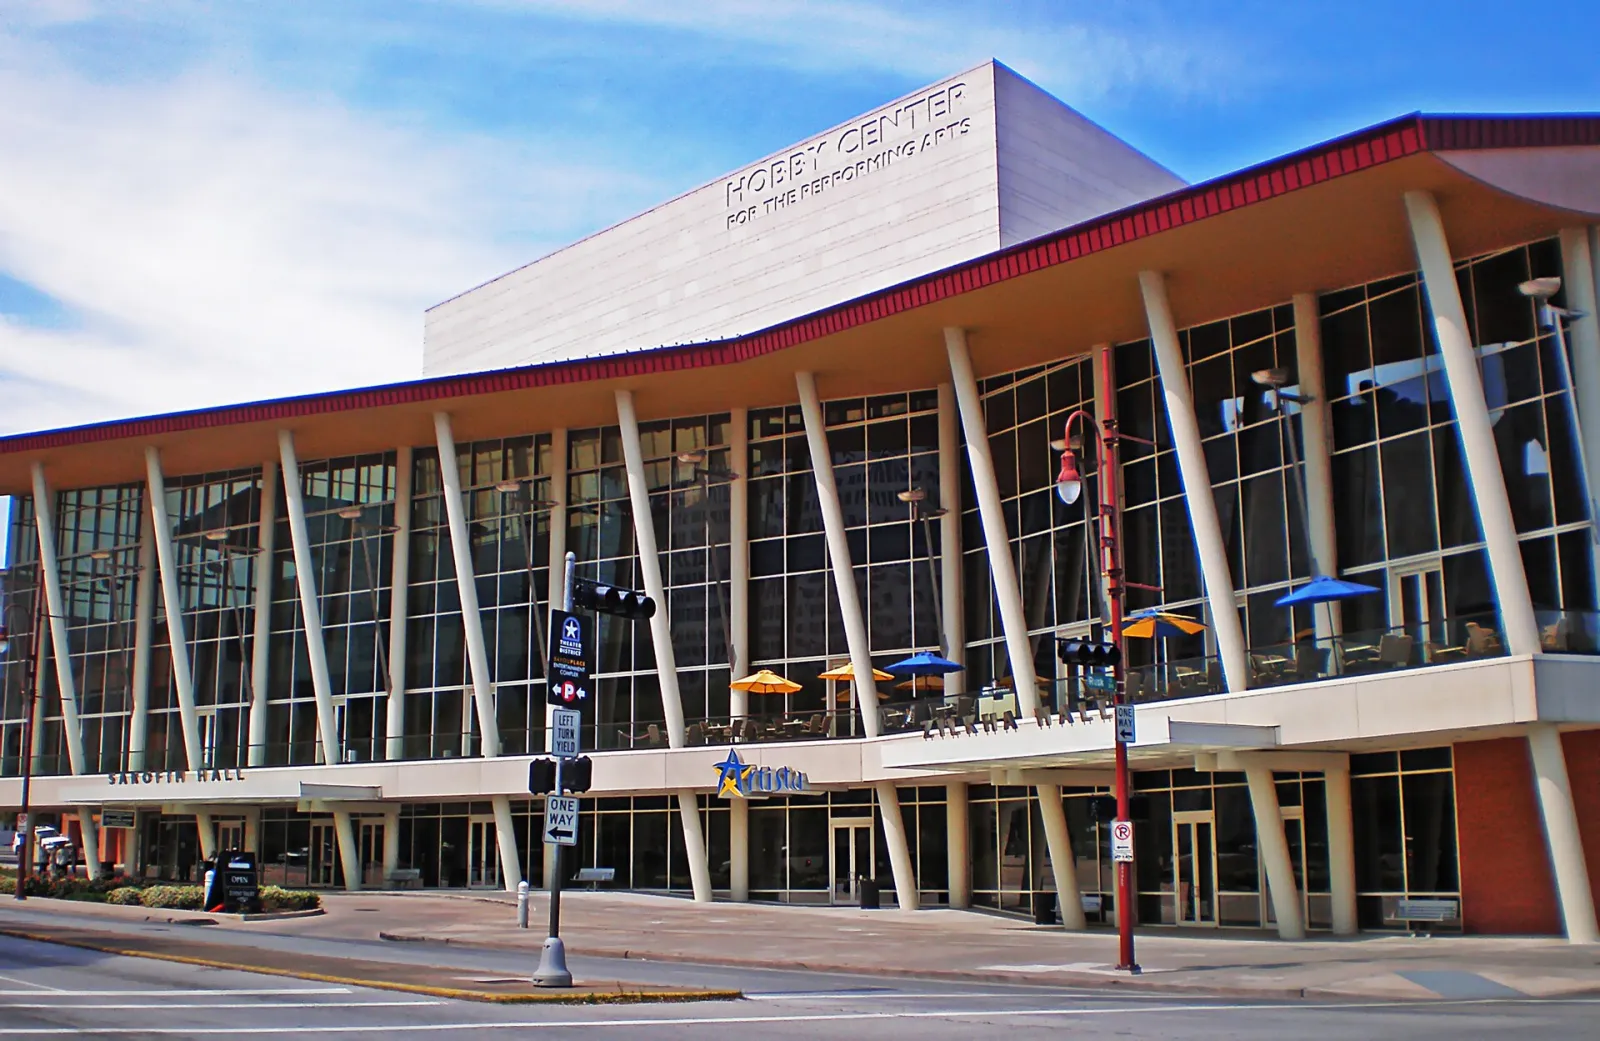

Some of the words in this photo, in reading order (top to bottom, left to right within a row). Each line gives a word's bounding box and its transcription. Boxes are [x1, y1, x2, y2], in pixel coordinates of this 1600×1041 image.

[726, 141, 827, 207] HOBBY
[837, 82, 967, 153] CENTER
[726, 205, 757, 230] FOR
[763, 189, 796, 214] THE
[800, 140, 916, 200] PERFORMING
[920, 117, 971, 152] ARTS
[560, 639, 582, 649] THEATER
[559, 647, 581, 656] DISTRICT
[564, 683, 575, 699] P
[1033, 698, 1113, 728] HALL
[1118, 707, 1132, 717] ONE
[558, 714, 574, 726] LEFT
[1118, 718, 1133, 727] WAY
[557, 727, 575, 740] TURN
[556, 740, 575, 753] YIELD
[197, 767, 246, 783] HALL
[712, 748, 804, 798] Artista
[550, 799, 575, 812] ONE
[549, 812, 574, 826] WAY
[231, 876, 249, 884] OPEN
